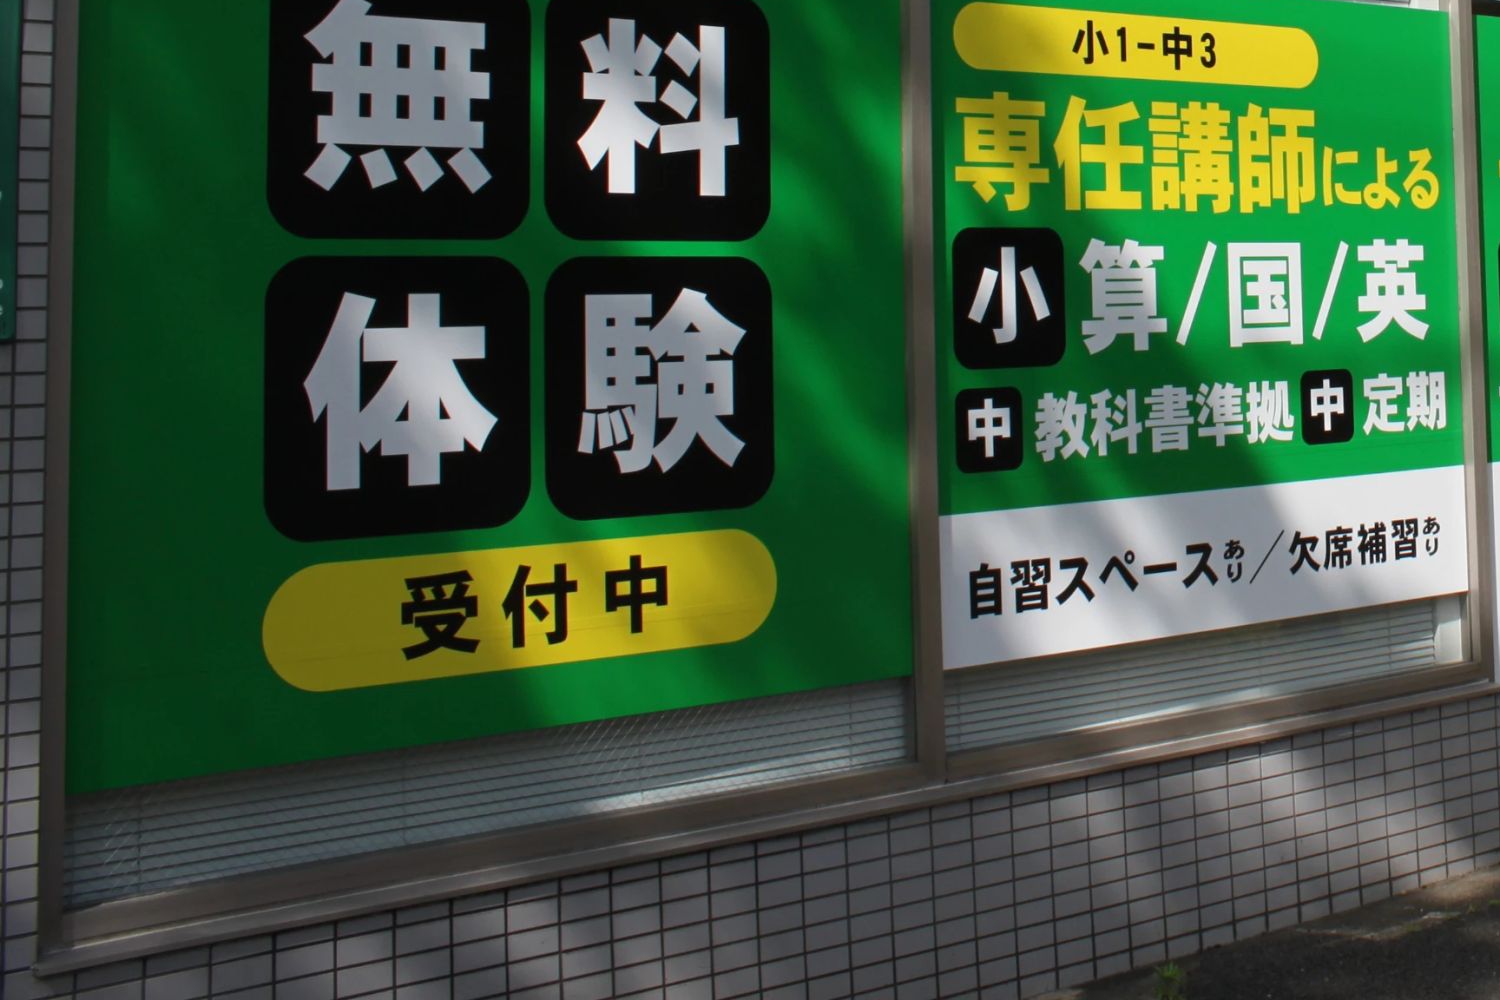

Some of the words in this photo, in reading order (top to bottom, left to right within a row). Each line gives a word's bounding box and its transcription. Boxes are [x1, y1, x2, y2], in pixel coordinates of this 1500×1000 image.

[954, 92, 1440, 214] 専任講師による
[967, 246, 1051, 345] 小
[303, 287, 747, 491] 体験
[967, 398, 1012, 459] 中
[1034, 381, 1294, 463] 教科書準拠
[1309, 379, 1347, 432] 中
[1362, 371, 1447, 434] 定期
[400, 553, 670, 661] 受付中
